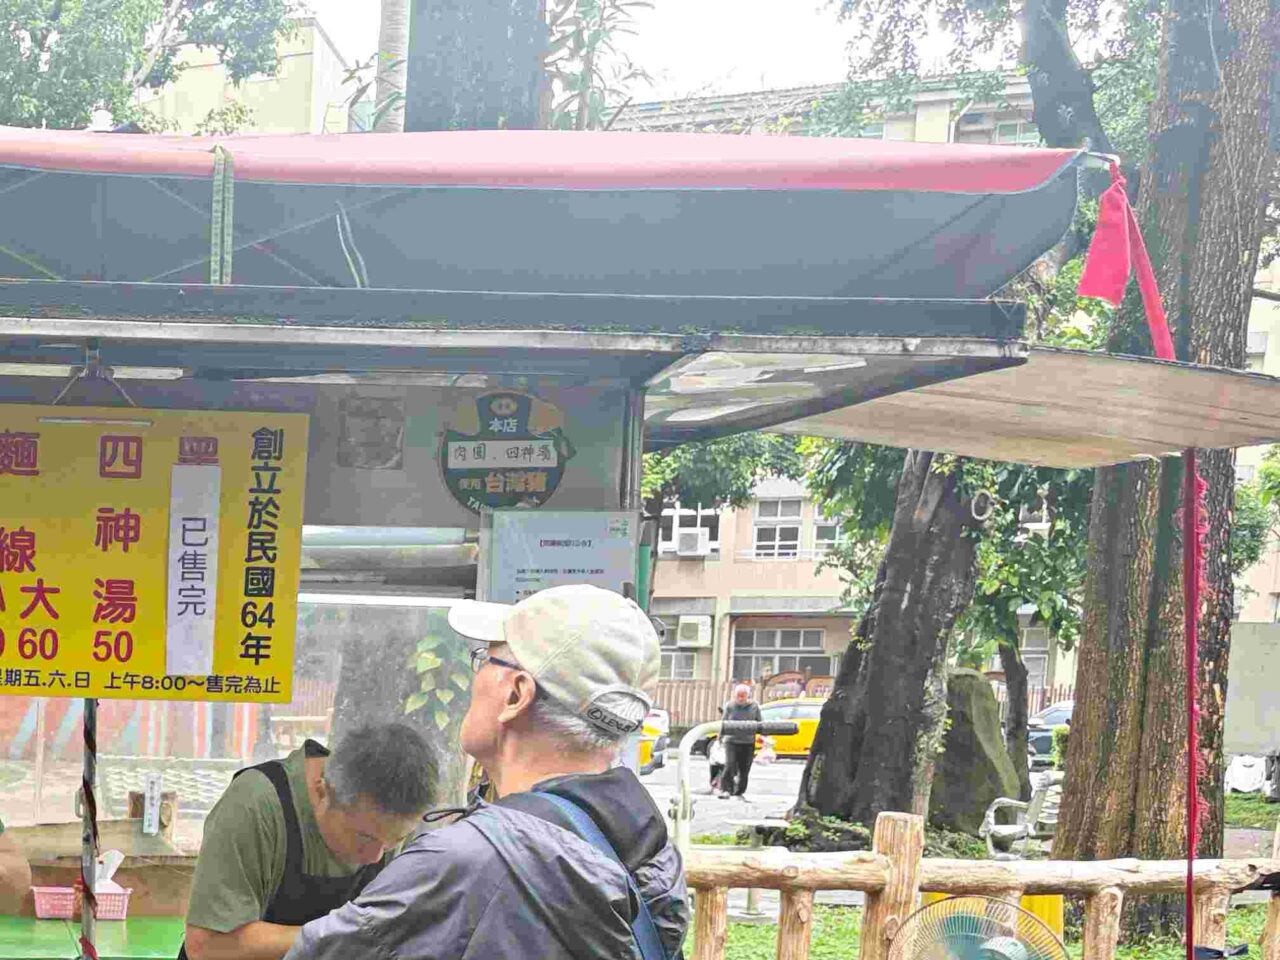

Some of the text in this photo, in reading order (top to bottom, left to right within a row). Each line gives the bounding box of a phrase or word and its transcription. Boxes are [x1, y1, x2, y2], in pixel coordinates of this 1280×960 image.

[488, 417, 519, 433] 本店
[91, 435, 143, 625] 四神湯
[176, 517, 210, 617] 已售完
[17, 628, 59, 662] 60
[92, 630, 134, 664] 50
